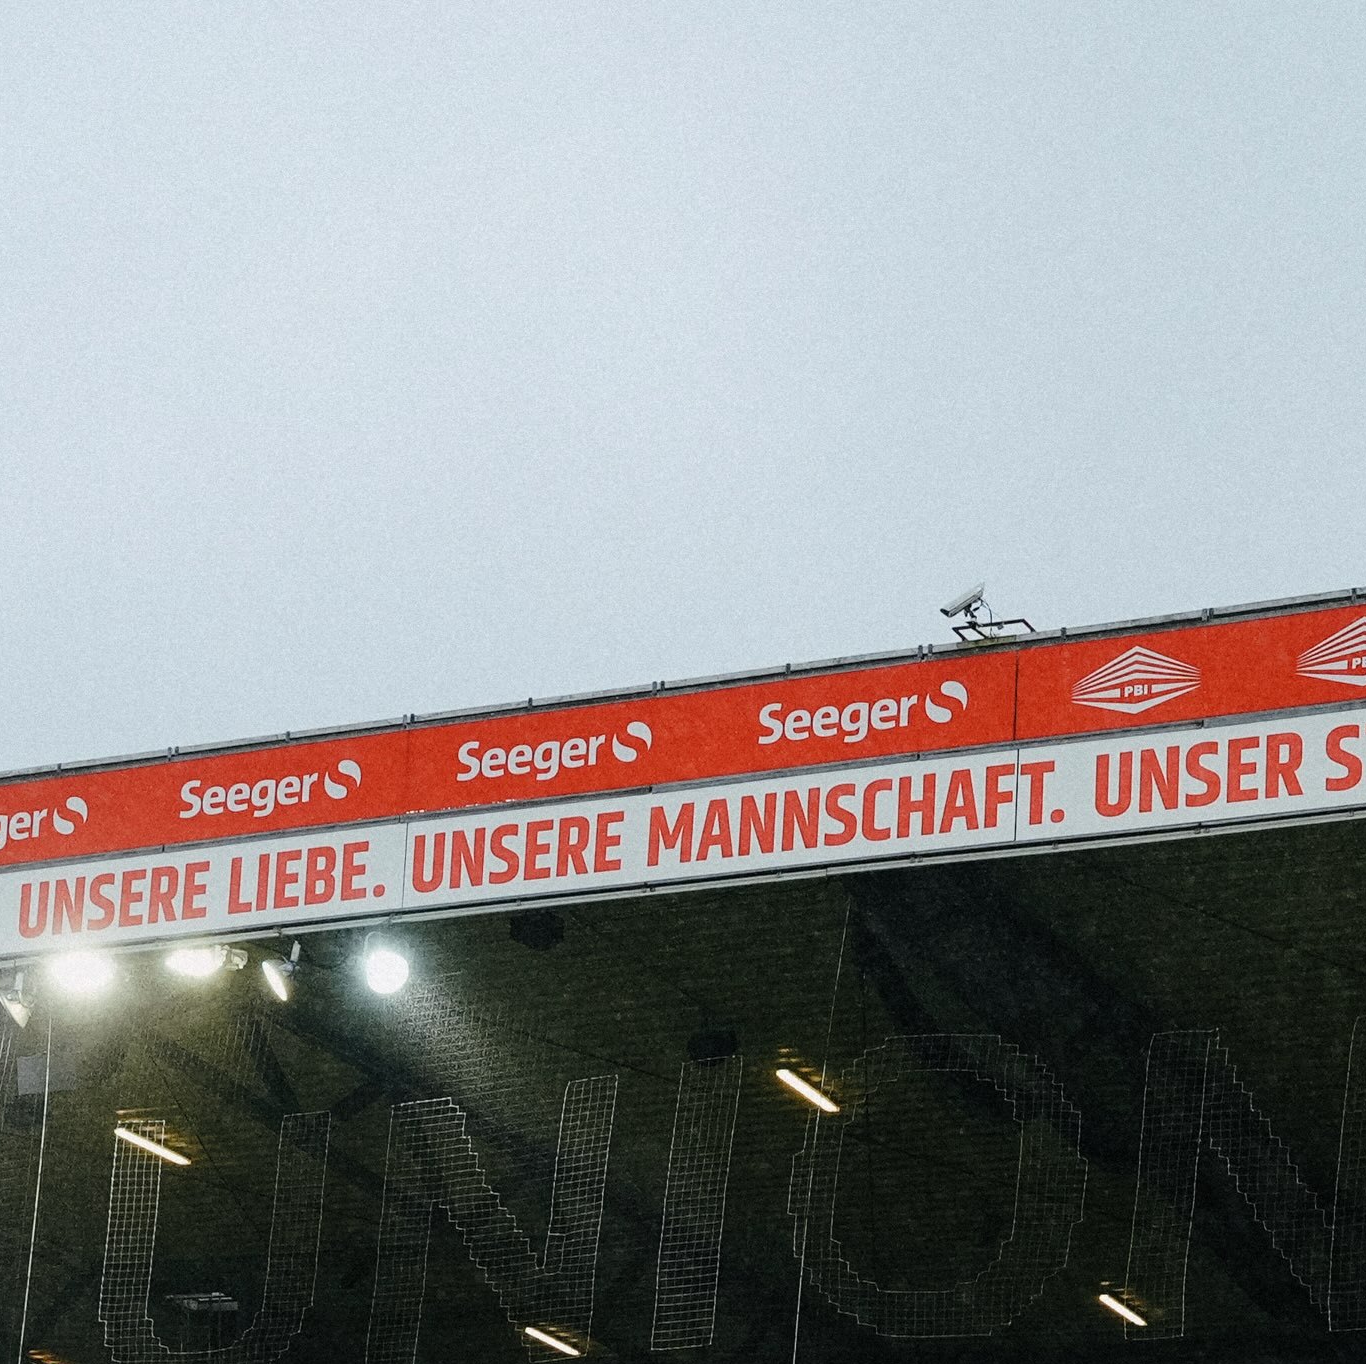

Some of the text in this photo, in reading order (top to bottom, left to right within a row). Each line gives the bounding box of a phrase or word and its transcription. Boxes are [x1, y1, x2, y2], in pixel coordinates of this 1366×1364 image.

[1124, 684, 1148, 698] PBI
[758, 693, 918, 745] Seeger
[457, 733, 605, 782] Seeger
[1094, 732, 1303, 816] UNSER
[179, 770, 318, 819] Seeger
[412, 760, 1065, 894] UNSERE MANNSCHAFT.
[18, 841, 386, 939] UNSERE LIEBE.
